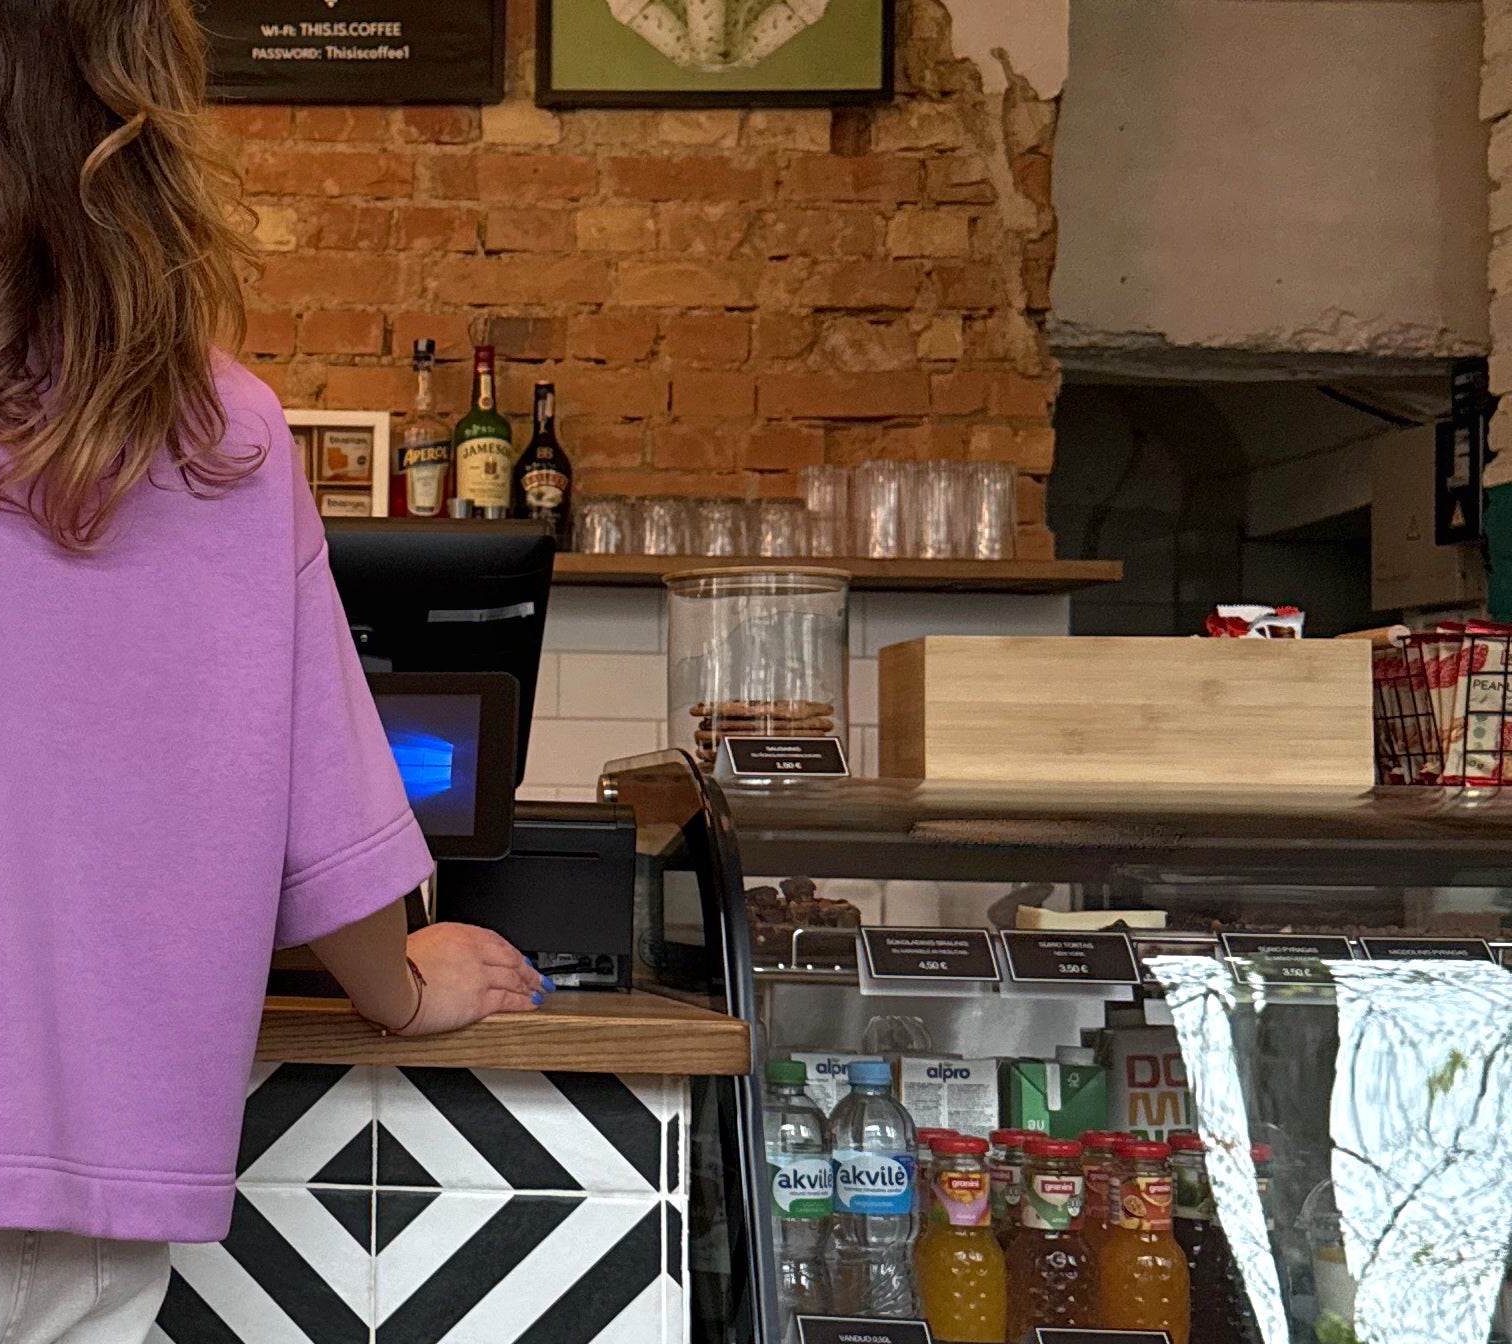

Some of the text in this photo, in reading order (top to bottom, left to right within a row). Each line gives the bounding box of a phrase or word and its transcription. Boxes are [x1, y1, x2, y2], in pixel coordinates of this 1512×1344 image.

[252, 47, 322, 59] PASSWORD:
[404, 446, 448, 465] APEROL
[816, 1058, 849, 1079] alpr
[927, 1062, 970, 1082] alpro
[840, 1165, 905, 1186] akvilė
